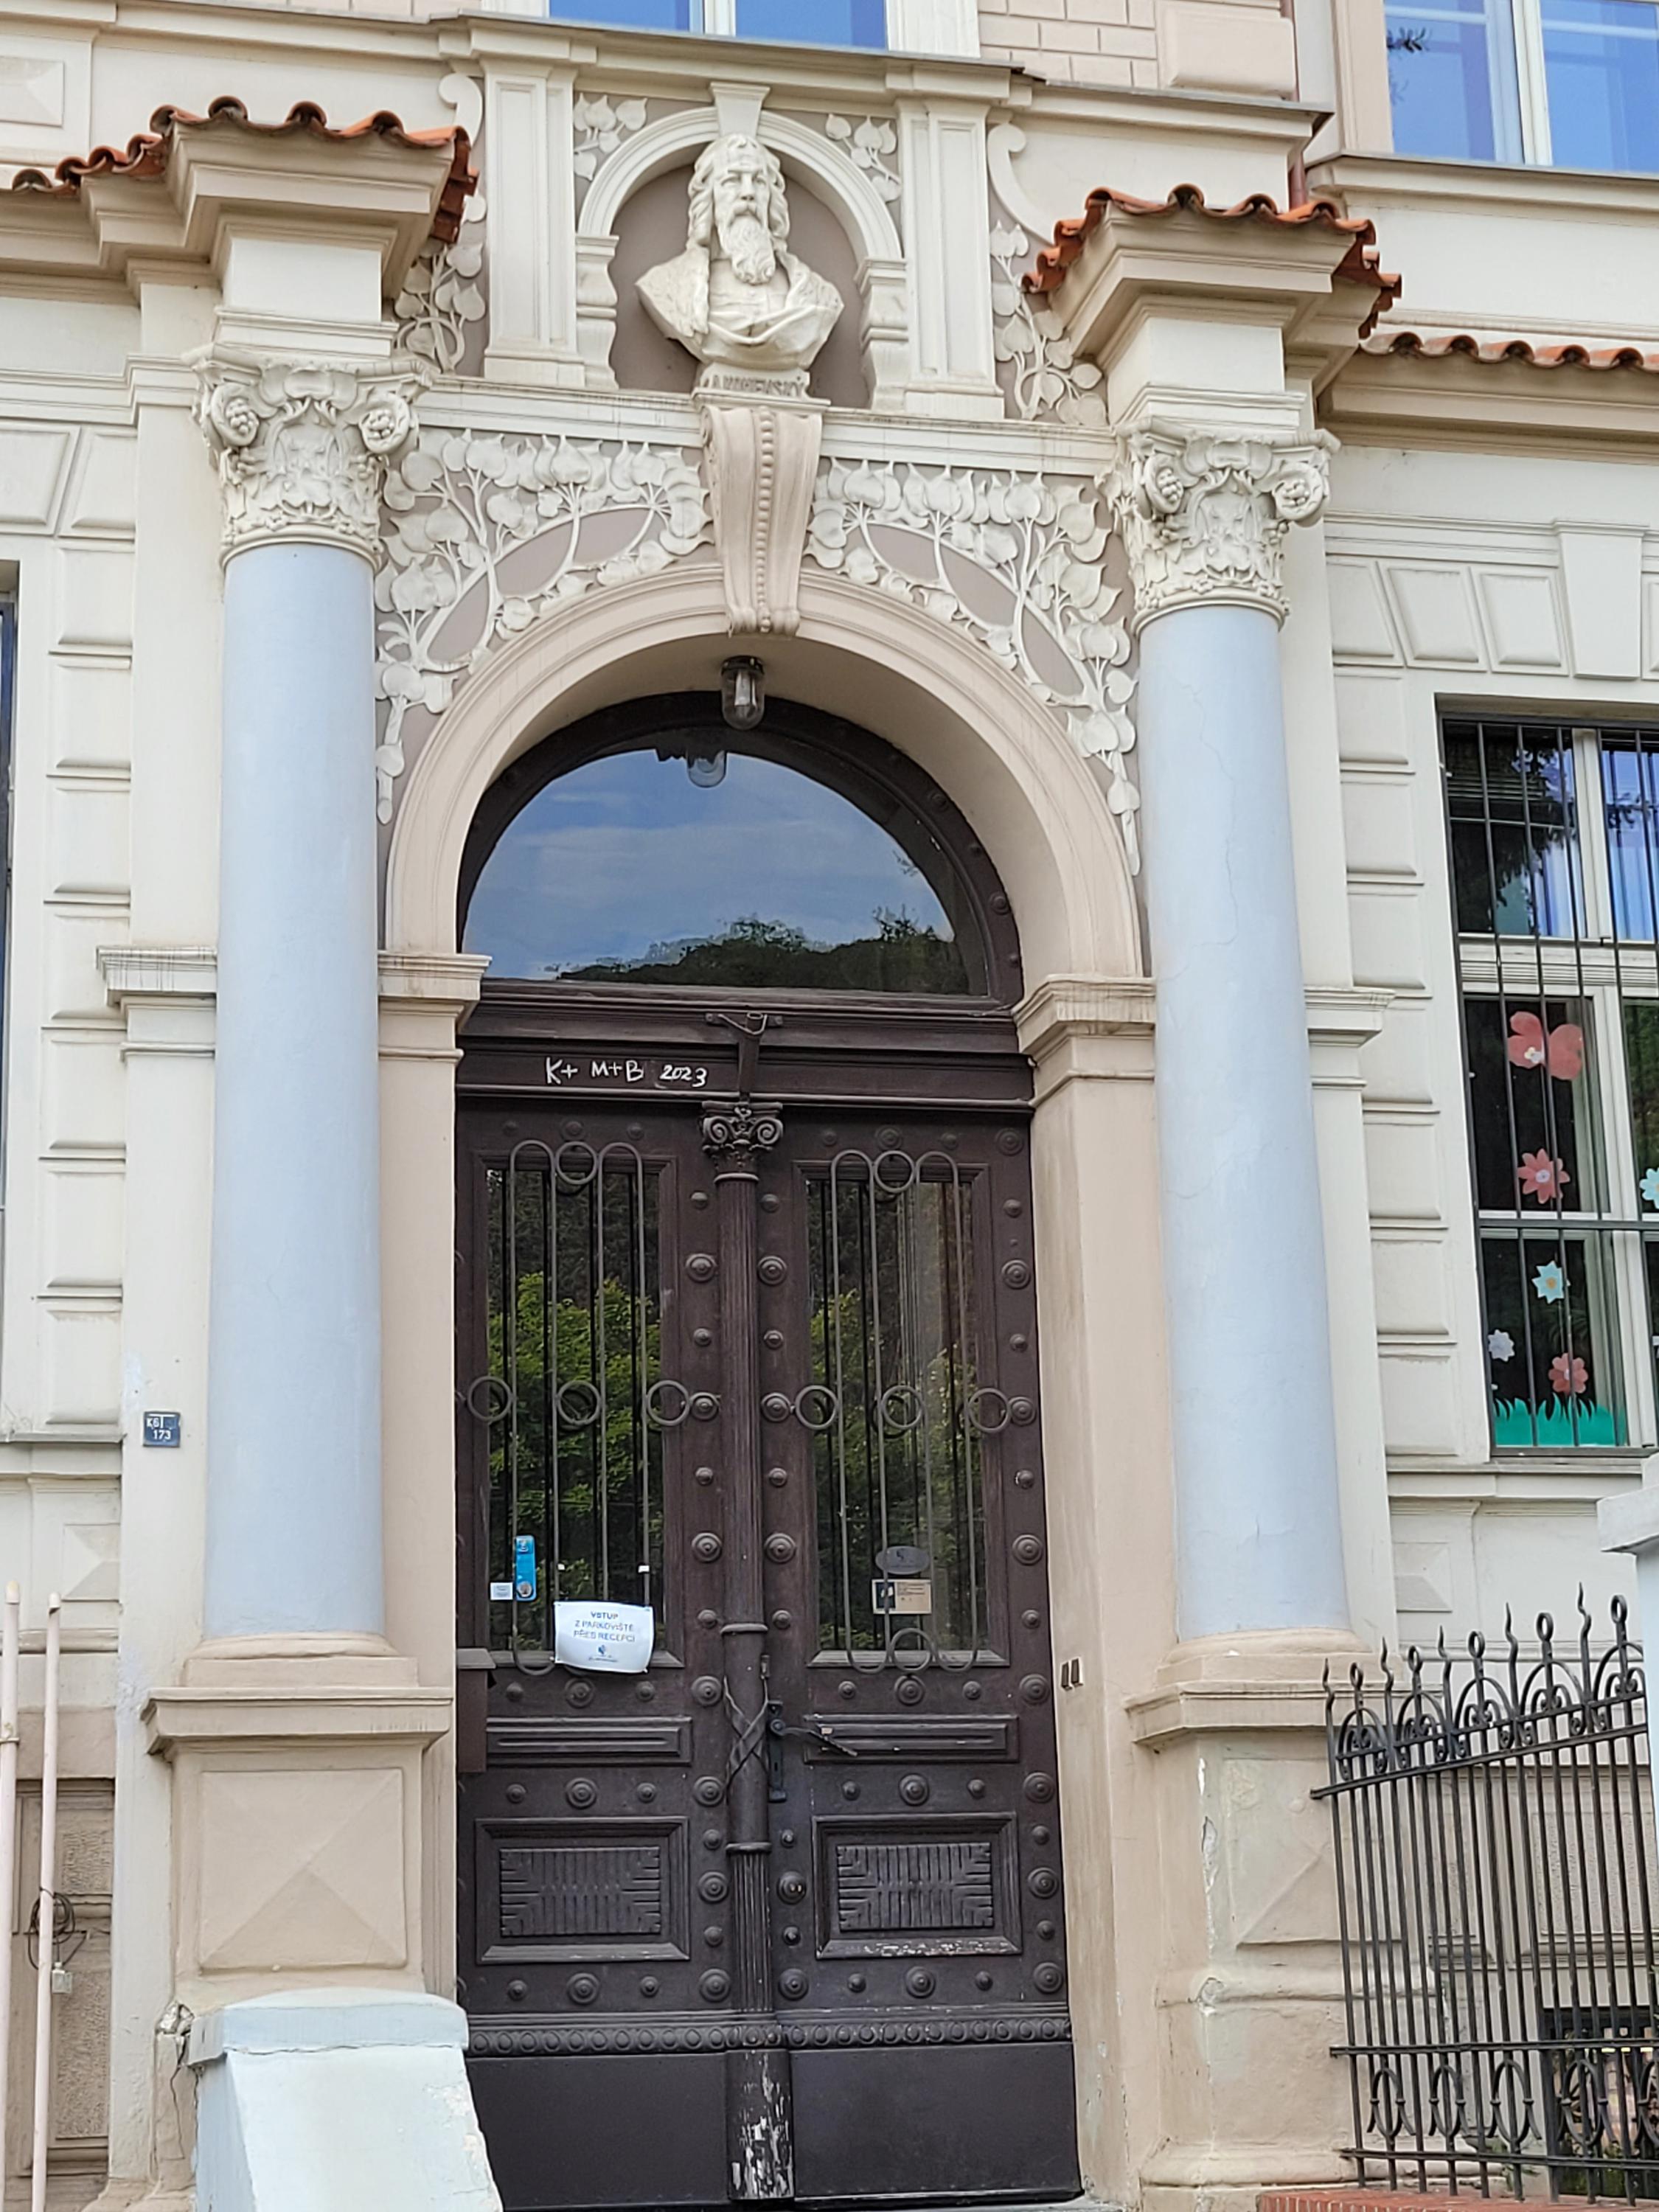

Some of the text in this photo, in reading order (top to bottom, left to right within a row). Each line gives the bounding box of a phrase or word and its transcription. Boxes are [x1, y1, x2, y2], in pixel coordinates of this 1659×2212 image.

[546, 1056, 708, 1088] K+ M+B 2023
[153, 1429, 172, 1440] 173
[591, 1611, 619, 1620] VSTUP
